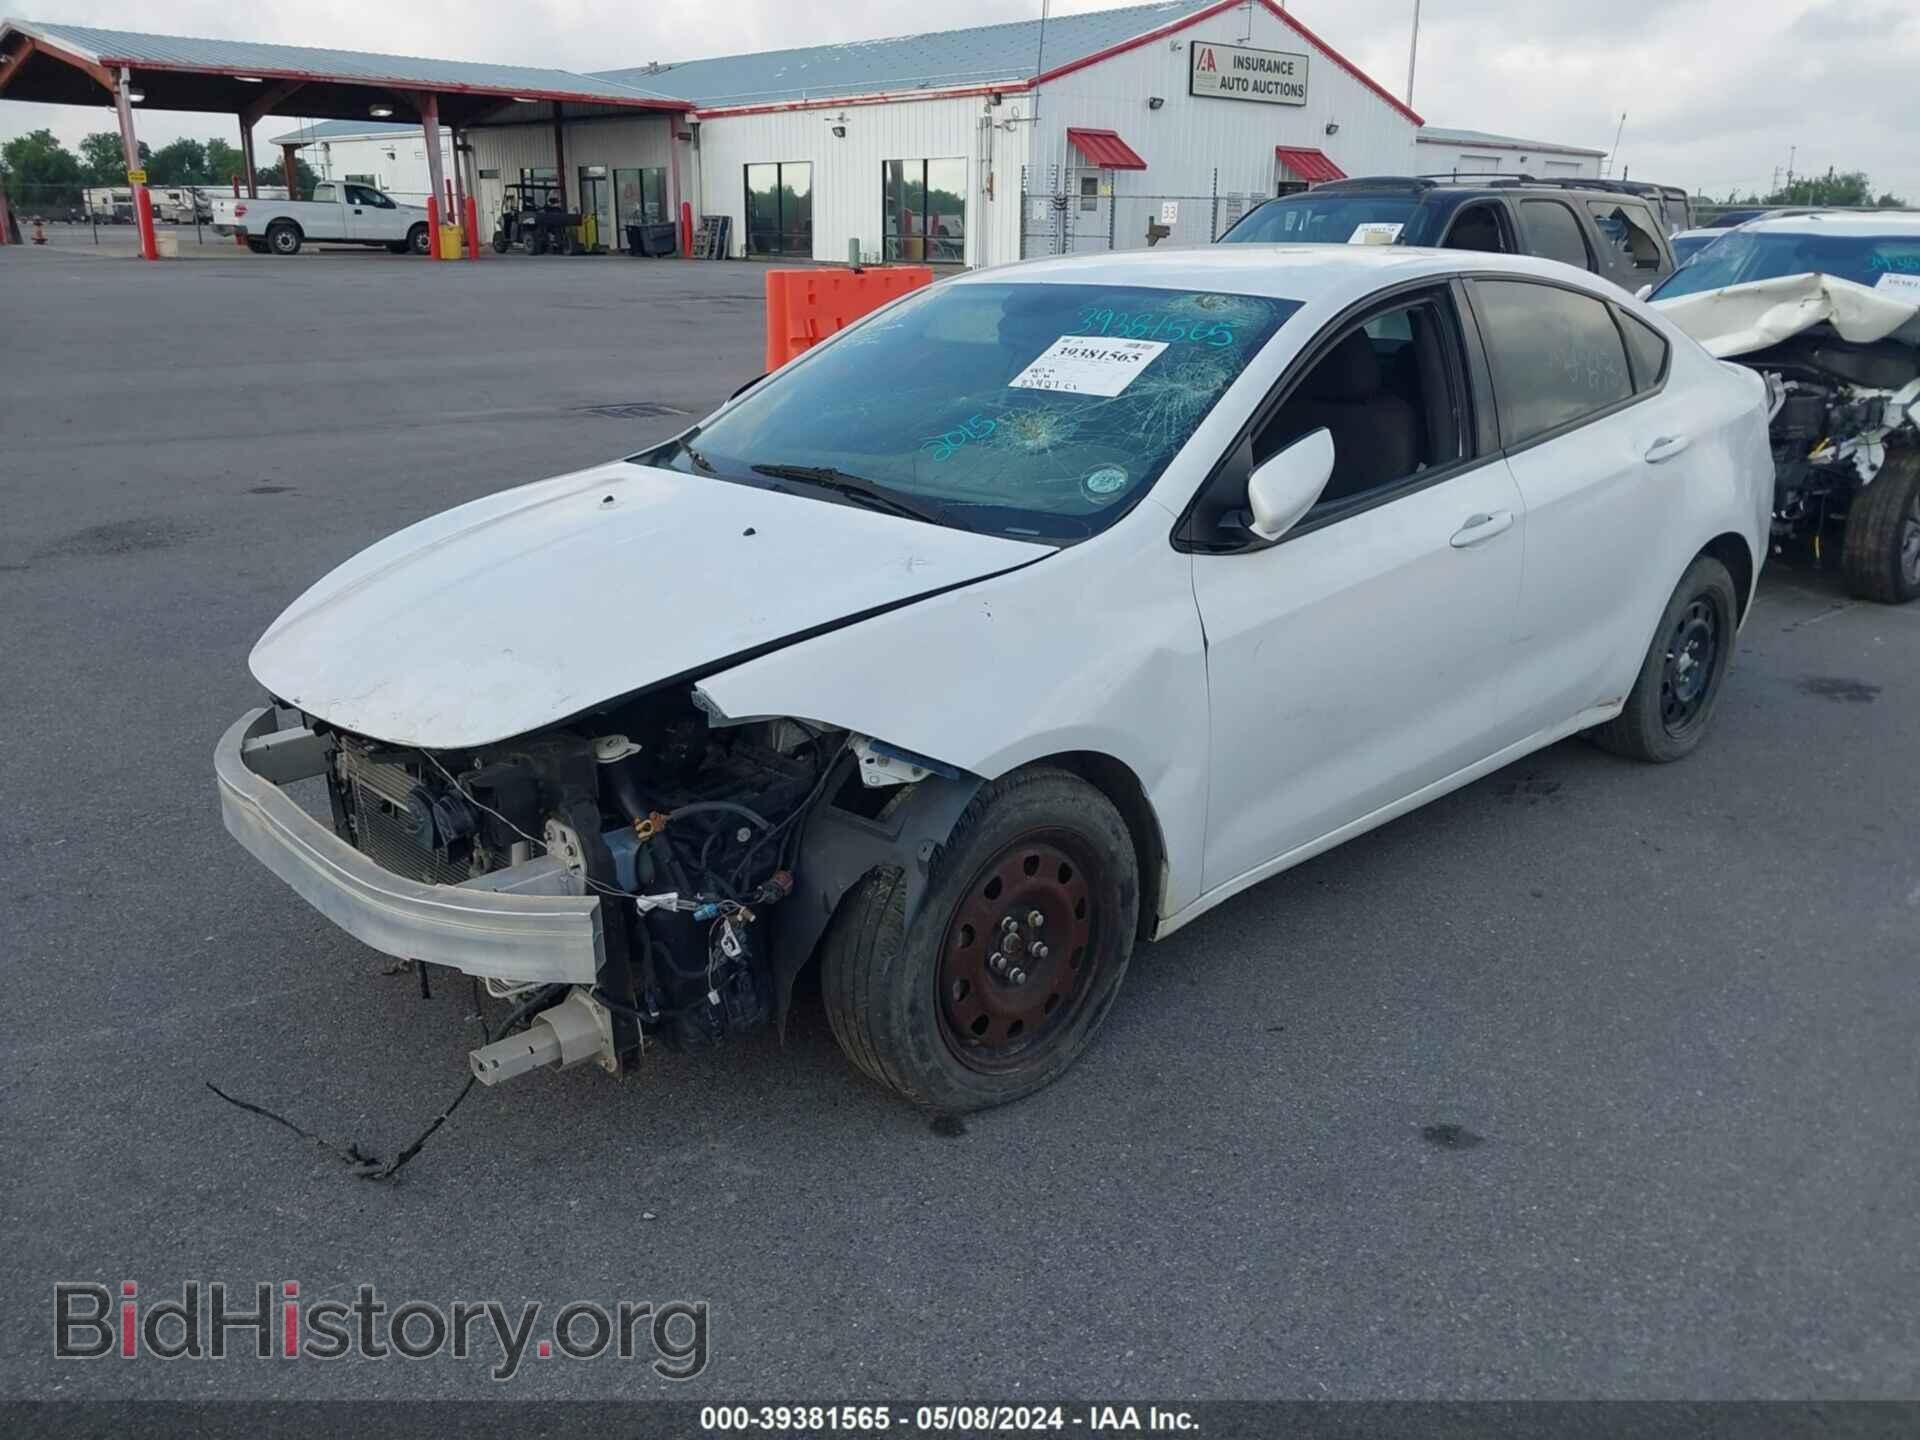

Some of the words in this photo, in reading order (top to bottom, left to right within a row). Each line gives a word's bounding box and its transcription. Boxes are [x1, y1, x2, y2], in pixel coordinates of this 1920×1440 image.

[1233, 55, 1294, 76] INSURANCE
[1219, 76, 1249, 92] AUTO
[1252, 79, 1305, 98] AUCTIONS
[1053, 347, 1143, 363] 39381565
[919, 412, 997, 462] 2015
